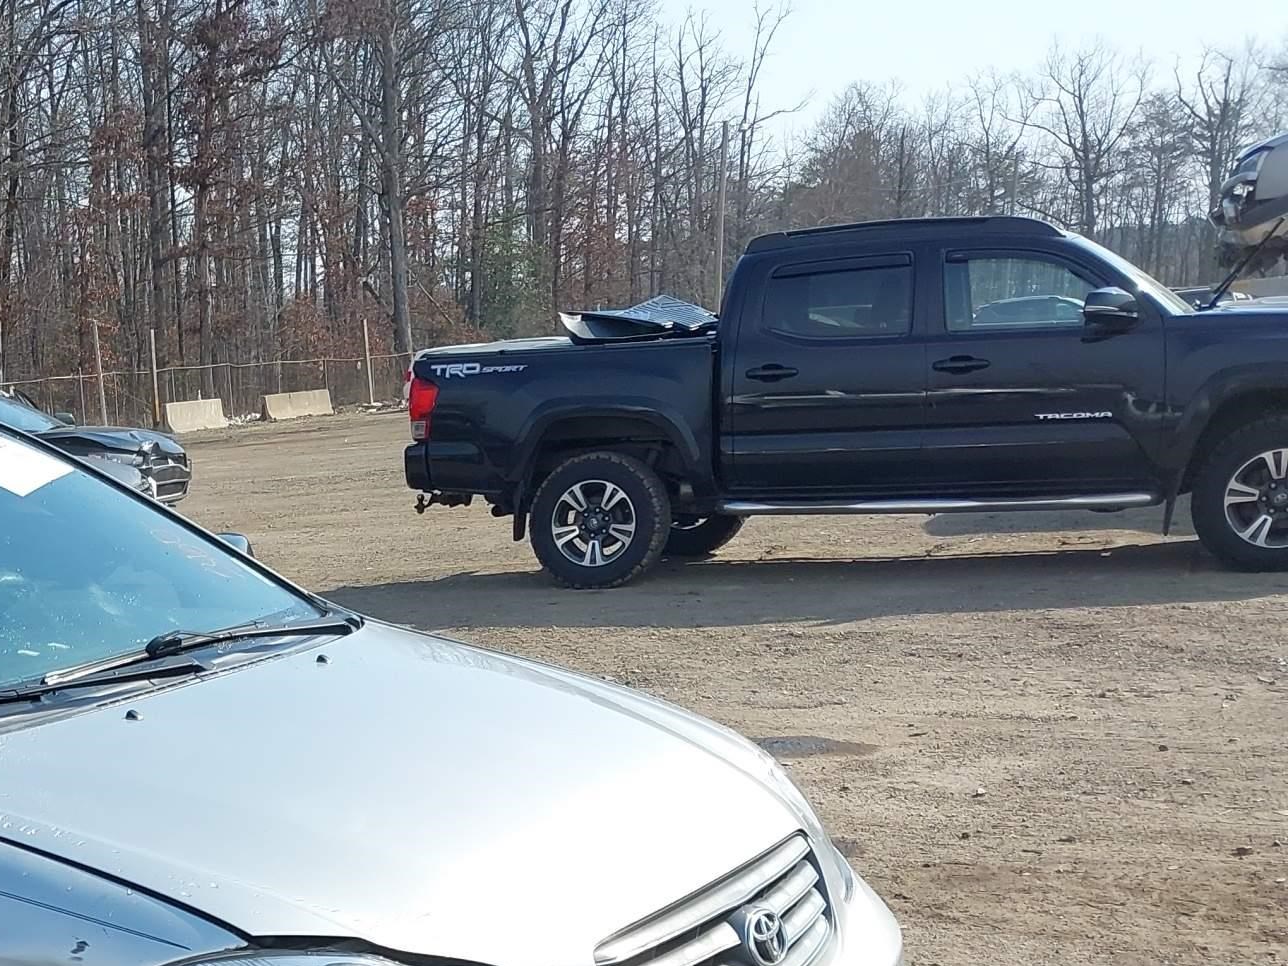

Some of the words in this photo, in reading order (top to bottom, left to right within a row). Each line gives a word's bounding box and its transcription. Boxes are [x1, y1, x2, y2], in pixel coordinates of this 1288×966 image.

[431, 363, 480, 378] TRD
[481, 365, 528, 373] SPORT
[1034, 411, 1113, 420] TACOMA
